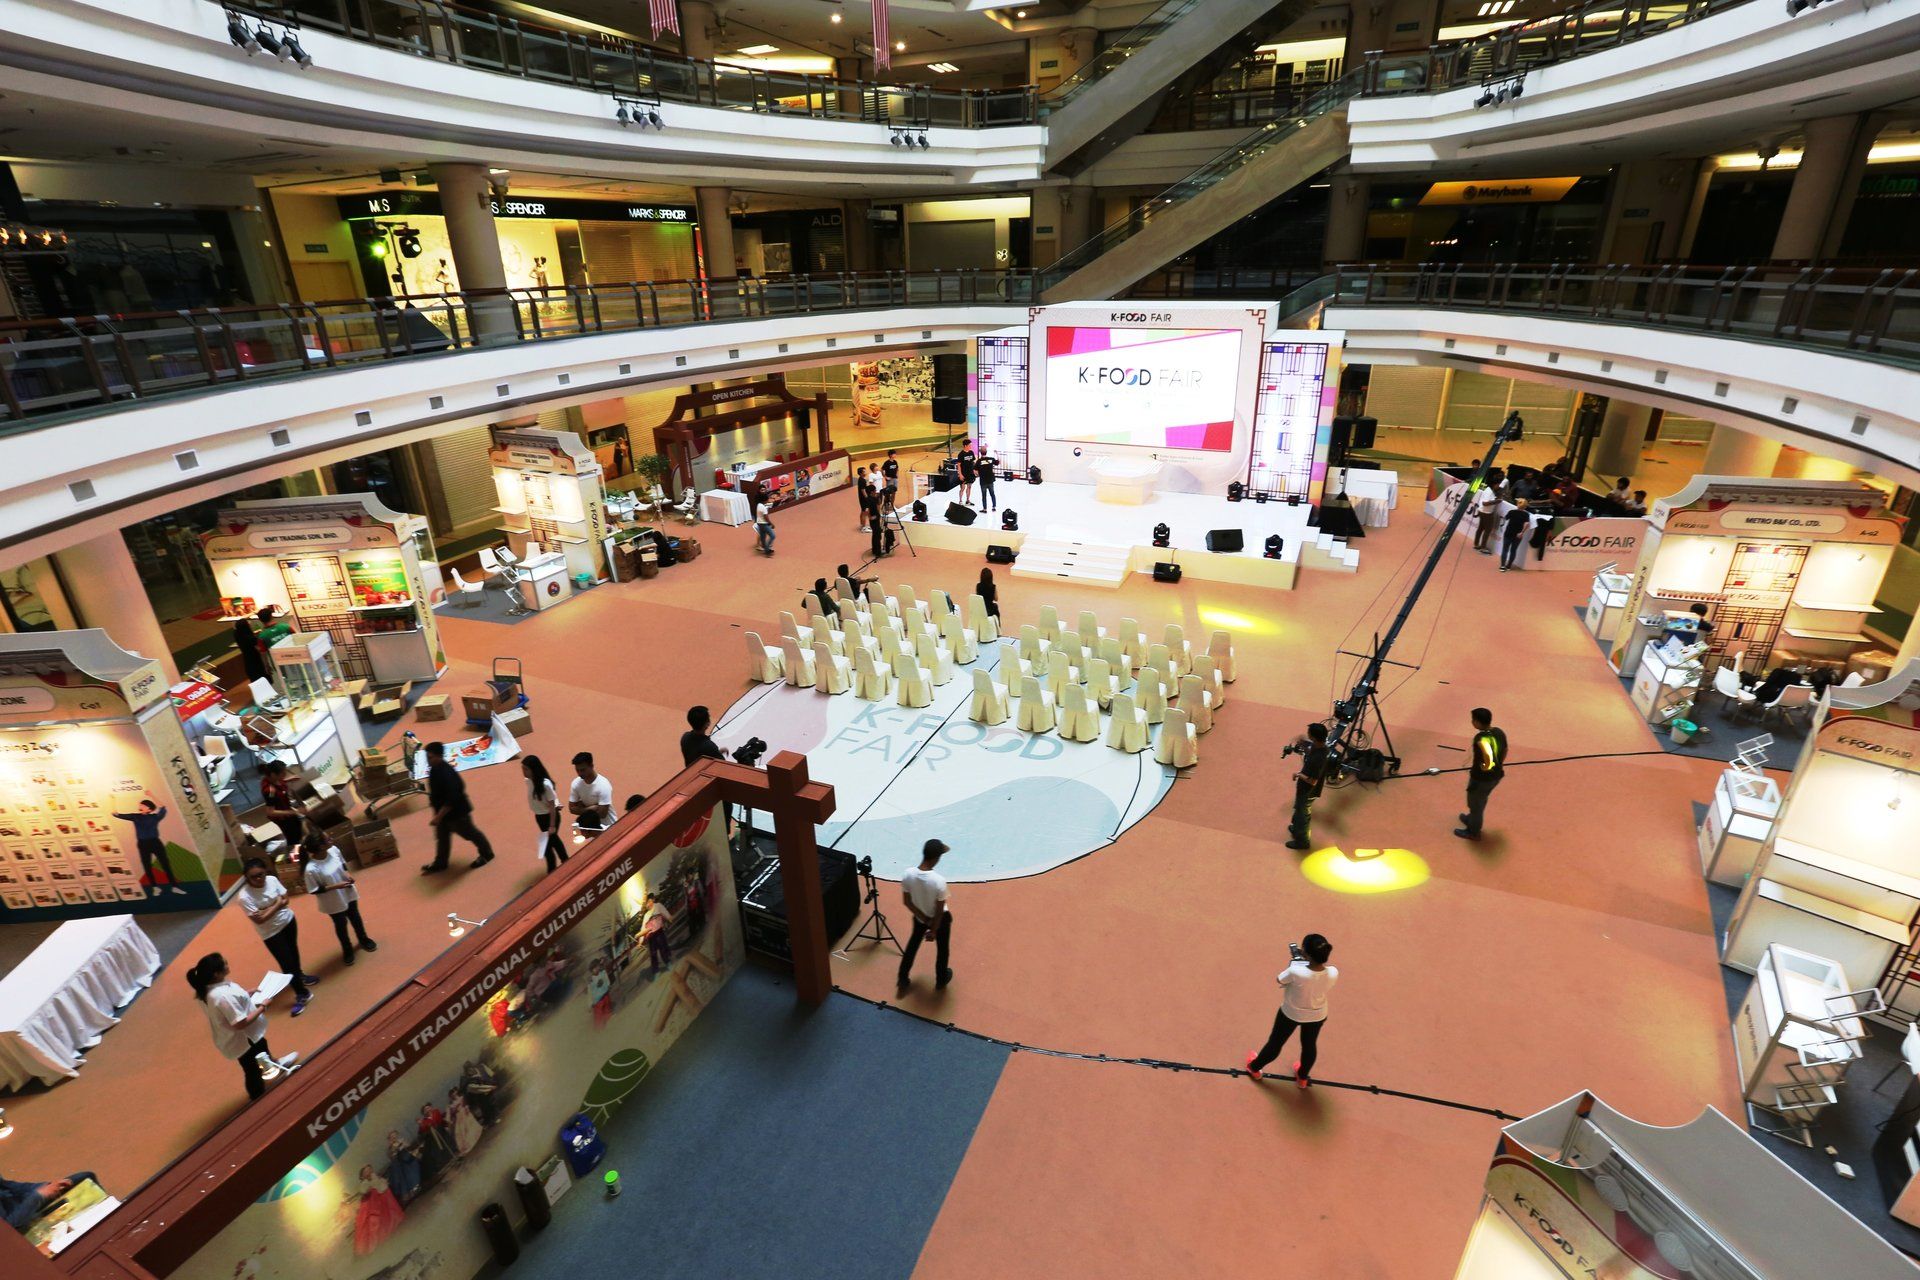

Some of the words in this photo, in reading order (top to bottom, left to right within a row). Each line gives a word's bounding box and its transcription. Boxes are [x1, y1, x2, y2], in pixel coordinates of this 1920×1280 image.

[1479, 186, 1532, 198] Maybank
[1110, 312, 1147, 322] K-FOOD
[1150, 313, 1172, 323] FAIR
[1078, 366, 1152, 386] K-FOOD
[1158, 368, 1204, 388] FAIR
[712, 391, 730, 401] OPEN
[730, 388, 755, 400] KITCHEN
[1745, 517, 1773, 525] METRO
[263, 534, 281, 543] KMT
[280, 533, 306, 542] TRADING
[1603, 536, 1635, 548] FAIR
[850, 702, 1064, 761] K-FOOD
[824, 726, 952, 772] FAIR
[1836, 735, 1884, 753] K-FOOD
[1884, 747, 1914, 760] FAIR
[170, 755, 198, 804] K-FOOD
[306, 1048, 406, 1139] KOREAN
[408, 946, 532, 1051] TRADITIONAL
[532, 889, 596, 947] CULTURE
[597, 857, 634, 895] ZONE
[1513, 1192, 1574, 1256] K-FOOD
